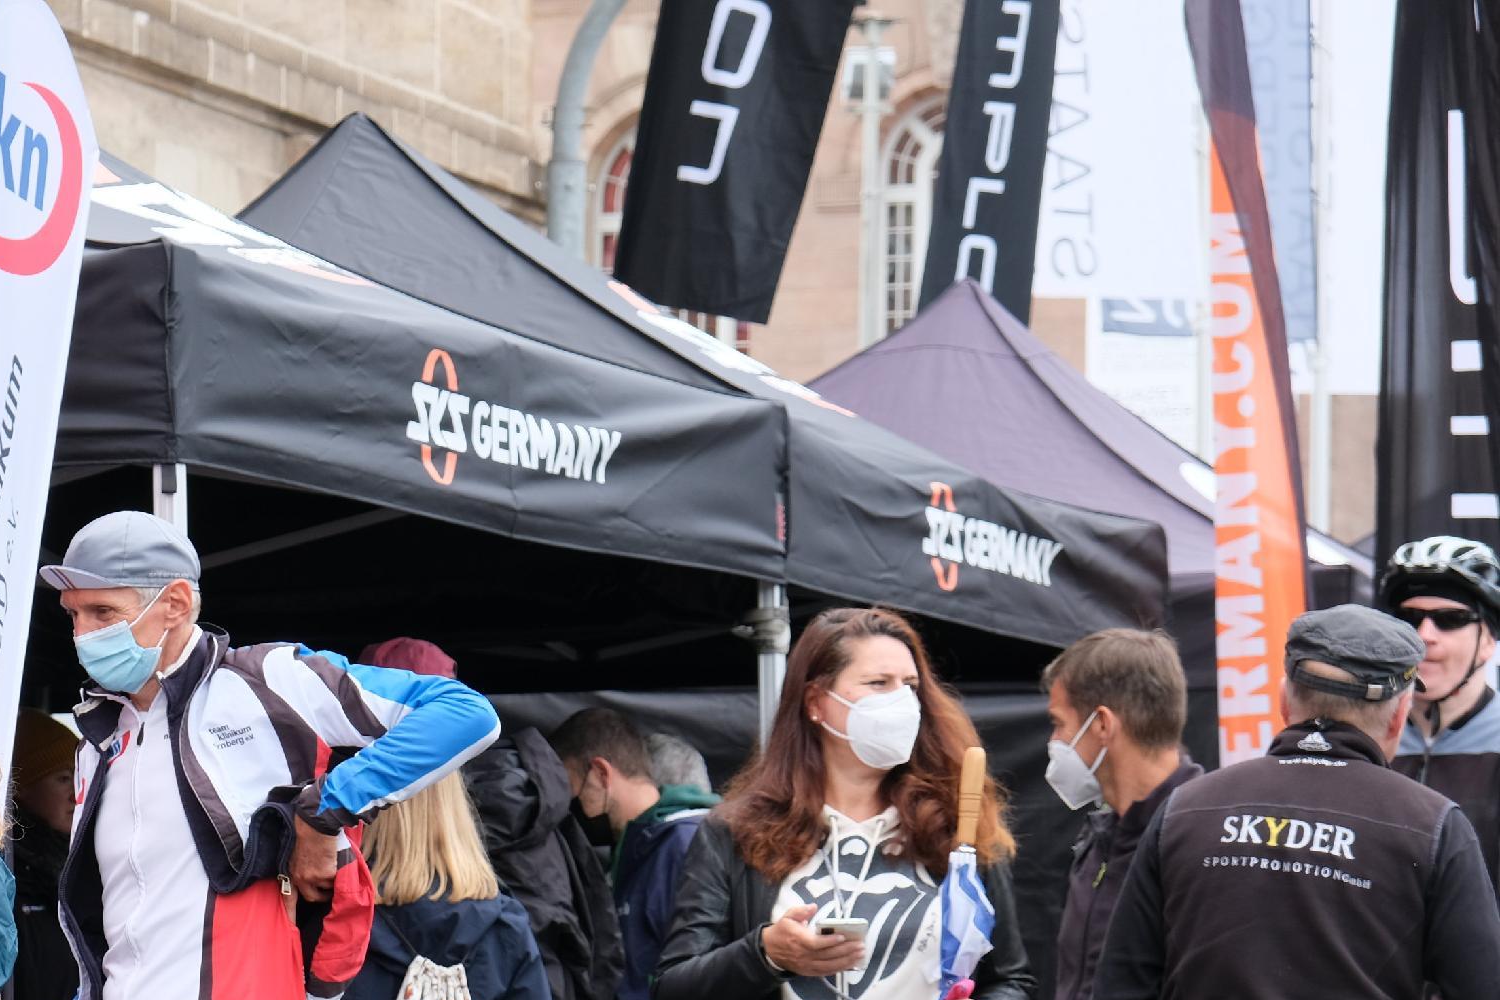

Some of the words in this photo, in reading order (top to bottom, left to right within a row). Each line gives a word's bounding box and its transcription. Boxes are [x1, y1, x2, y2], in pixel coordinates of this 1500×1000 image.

[406, 381, 470, 453] SKS
[471, 400, 622, 485] GERMANY
[964, 517, 1064, 587] GERMANY
[217, 726, 252, 741] klinikum
[1220, 814, 1355, 860] SKYDER
[1202, 856, 1341, 881] SPORTPROMOTION
